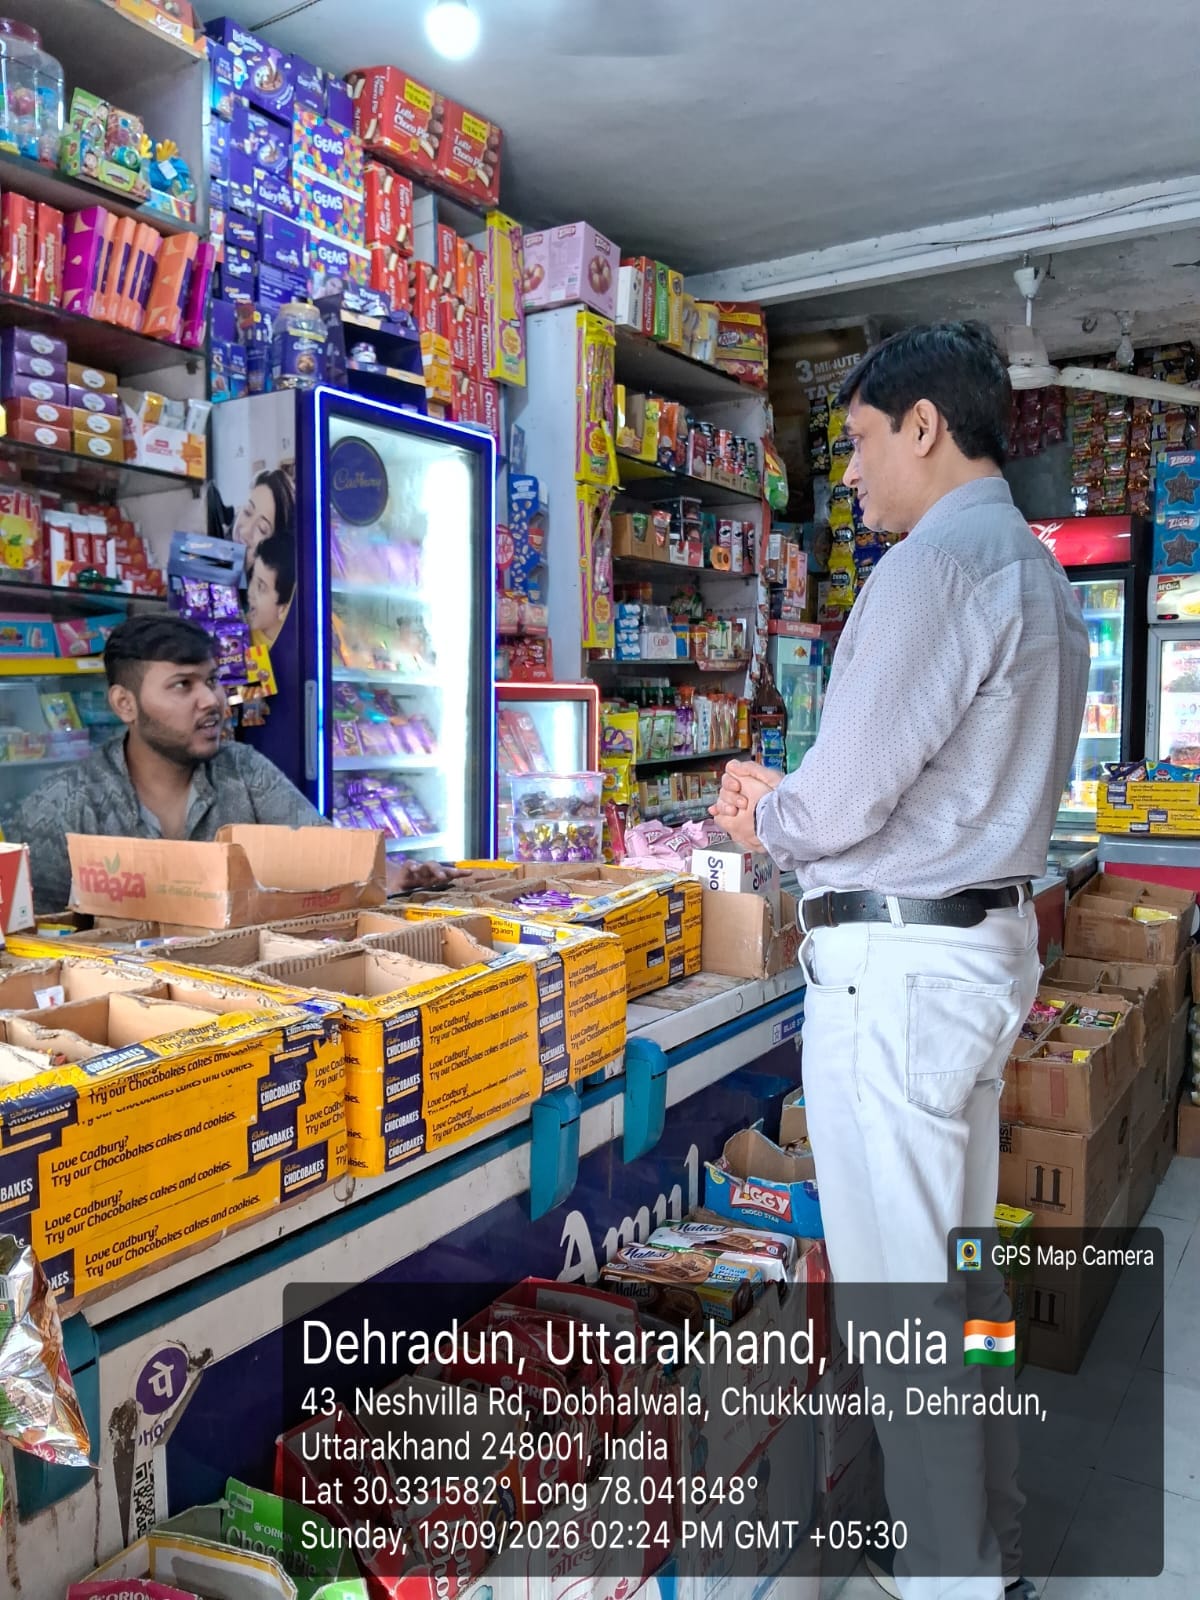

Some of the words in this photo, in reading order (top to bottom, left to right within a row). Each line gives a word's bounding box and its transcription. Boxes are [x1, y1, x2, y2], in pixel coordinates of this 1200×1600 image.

[313, 134, 344, 155] GEMS
[313, 190, 343, 210] GEMS
[318, 247, 348, 264] GEMS
[795, 359, 814, 384] 3
[814, 353, 861, 374] MINUTE
[804, 381, 841, 400] TAS
[79, 865, 146, 903] maaza
[707, 856, 724, 891] SNO
[429, 1034, 441, 1045] Try
[441, 1029, 451, 1040] our
[451, 1016, 484, 1036] Chocobakes
[484, 1011, 499, 1023] cakes
[499, 1006, 509, 1017] and
[429, 1023, 443, 1035] Love
[386, 1036, 421, 1058] CHOCOBAKES
[429, 1070, 441, 1081] Try
[440, 1066, 451, 1077] our
[450, 1050, 484, 1071] Chocobakes
[484, 1043, 499, 1056] cakes
[499, 1038, 509, 1049] and
[429, 1058, 443, 1071] Love
[88, 1090, 108, 1105] Try
[109, 1083, 127, 1099] our
[129, 1066, 187, 1093] Chocobakes
[188, 1055, 213, 1072] cakes
[260, 1080, 302, 1105] CHOCOBAKES
[385, 1073, 421, 1097] CHOCOBAKES
[427, 1094, 442, 1109] Love
[305, 1109, 323, 1124] Love
[384, 1110, 420, 1134] CHOCOBAKES
[432, 1131, 443, 1142] Try
[443, 1126, 453, 1136] our
[453, 1111, 487, 1132] Chocobakes
[486, 1104, 502, 1117] cakes
[501, 1098, 512, 1109] and
[432, 1120, 446, 1132] Love
[251, 1126, 294, 1154] CHOCOBAKES
[305, 1125, 320, 1136] Try
[51, 1172, 71, 1187] Try
[73, 1166, 92, 1180] our
[94, 1143, 154, 1172] Chocobakes
[155, 1132, 183, 1148] cakes
[184, 1122, 202, 1138] and
[51, 1158, 78, 1174] Love
[80, 1136, 129, 1162] Cadbury?
[388, 1134, 424, 1159] CHOCOBAKES
[283, 1159, 325, 1187] CHOCOBAKES
[44, 1216, 72, 1232] Love
[73, 1190, 123, 1220] Cadbury?
[45, 1231, 65, 1246] Try
[66, 1225, 86, 1239] our
[87, 1198, 148, 1228] Chocobakes
[149, 1184, 177, 1201] cakes
[178, 1174, 197, 1190] and
[741, 1209, 763, 1217] CHOCO
[764, 1214, 780, 1223] STAR
[85, 1265, 104, 1279] Try
[105, 1257, 123, 1271] our
[124, 1230, 182, 1262] Chocobakes
[184, 1217, 209, 1234] cakes
[210, 1208, 228, 1223] and
[85, 1251, 111, 1266] Love
[112, 1225, 160, 1255] Cadbury?
[148, 1361, 175, 1401] पे
